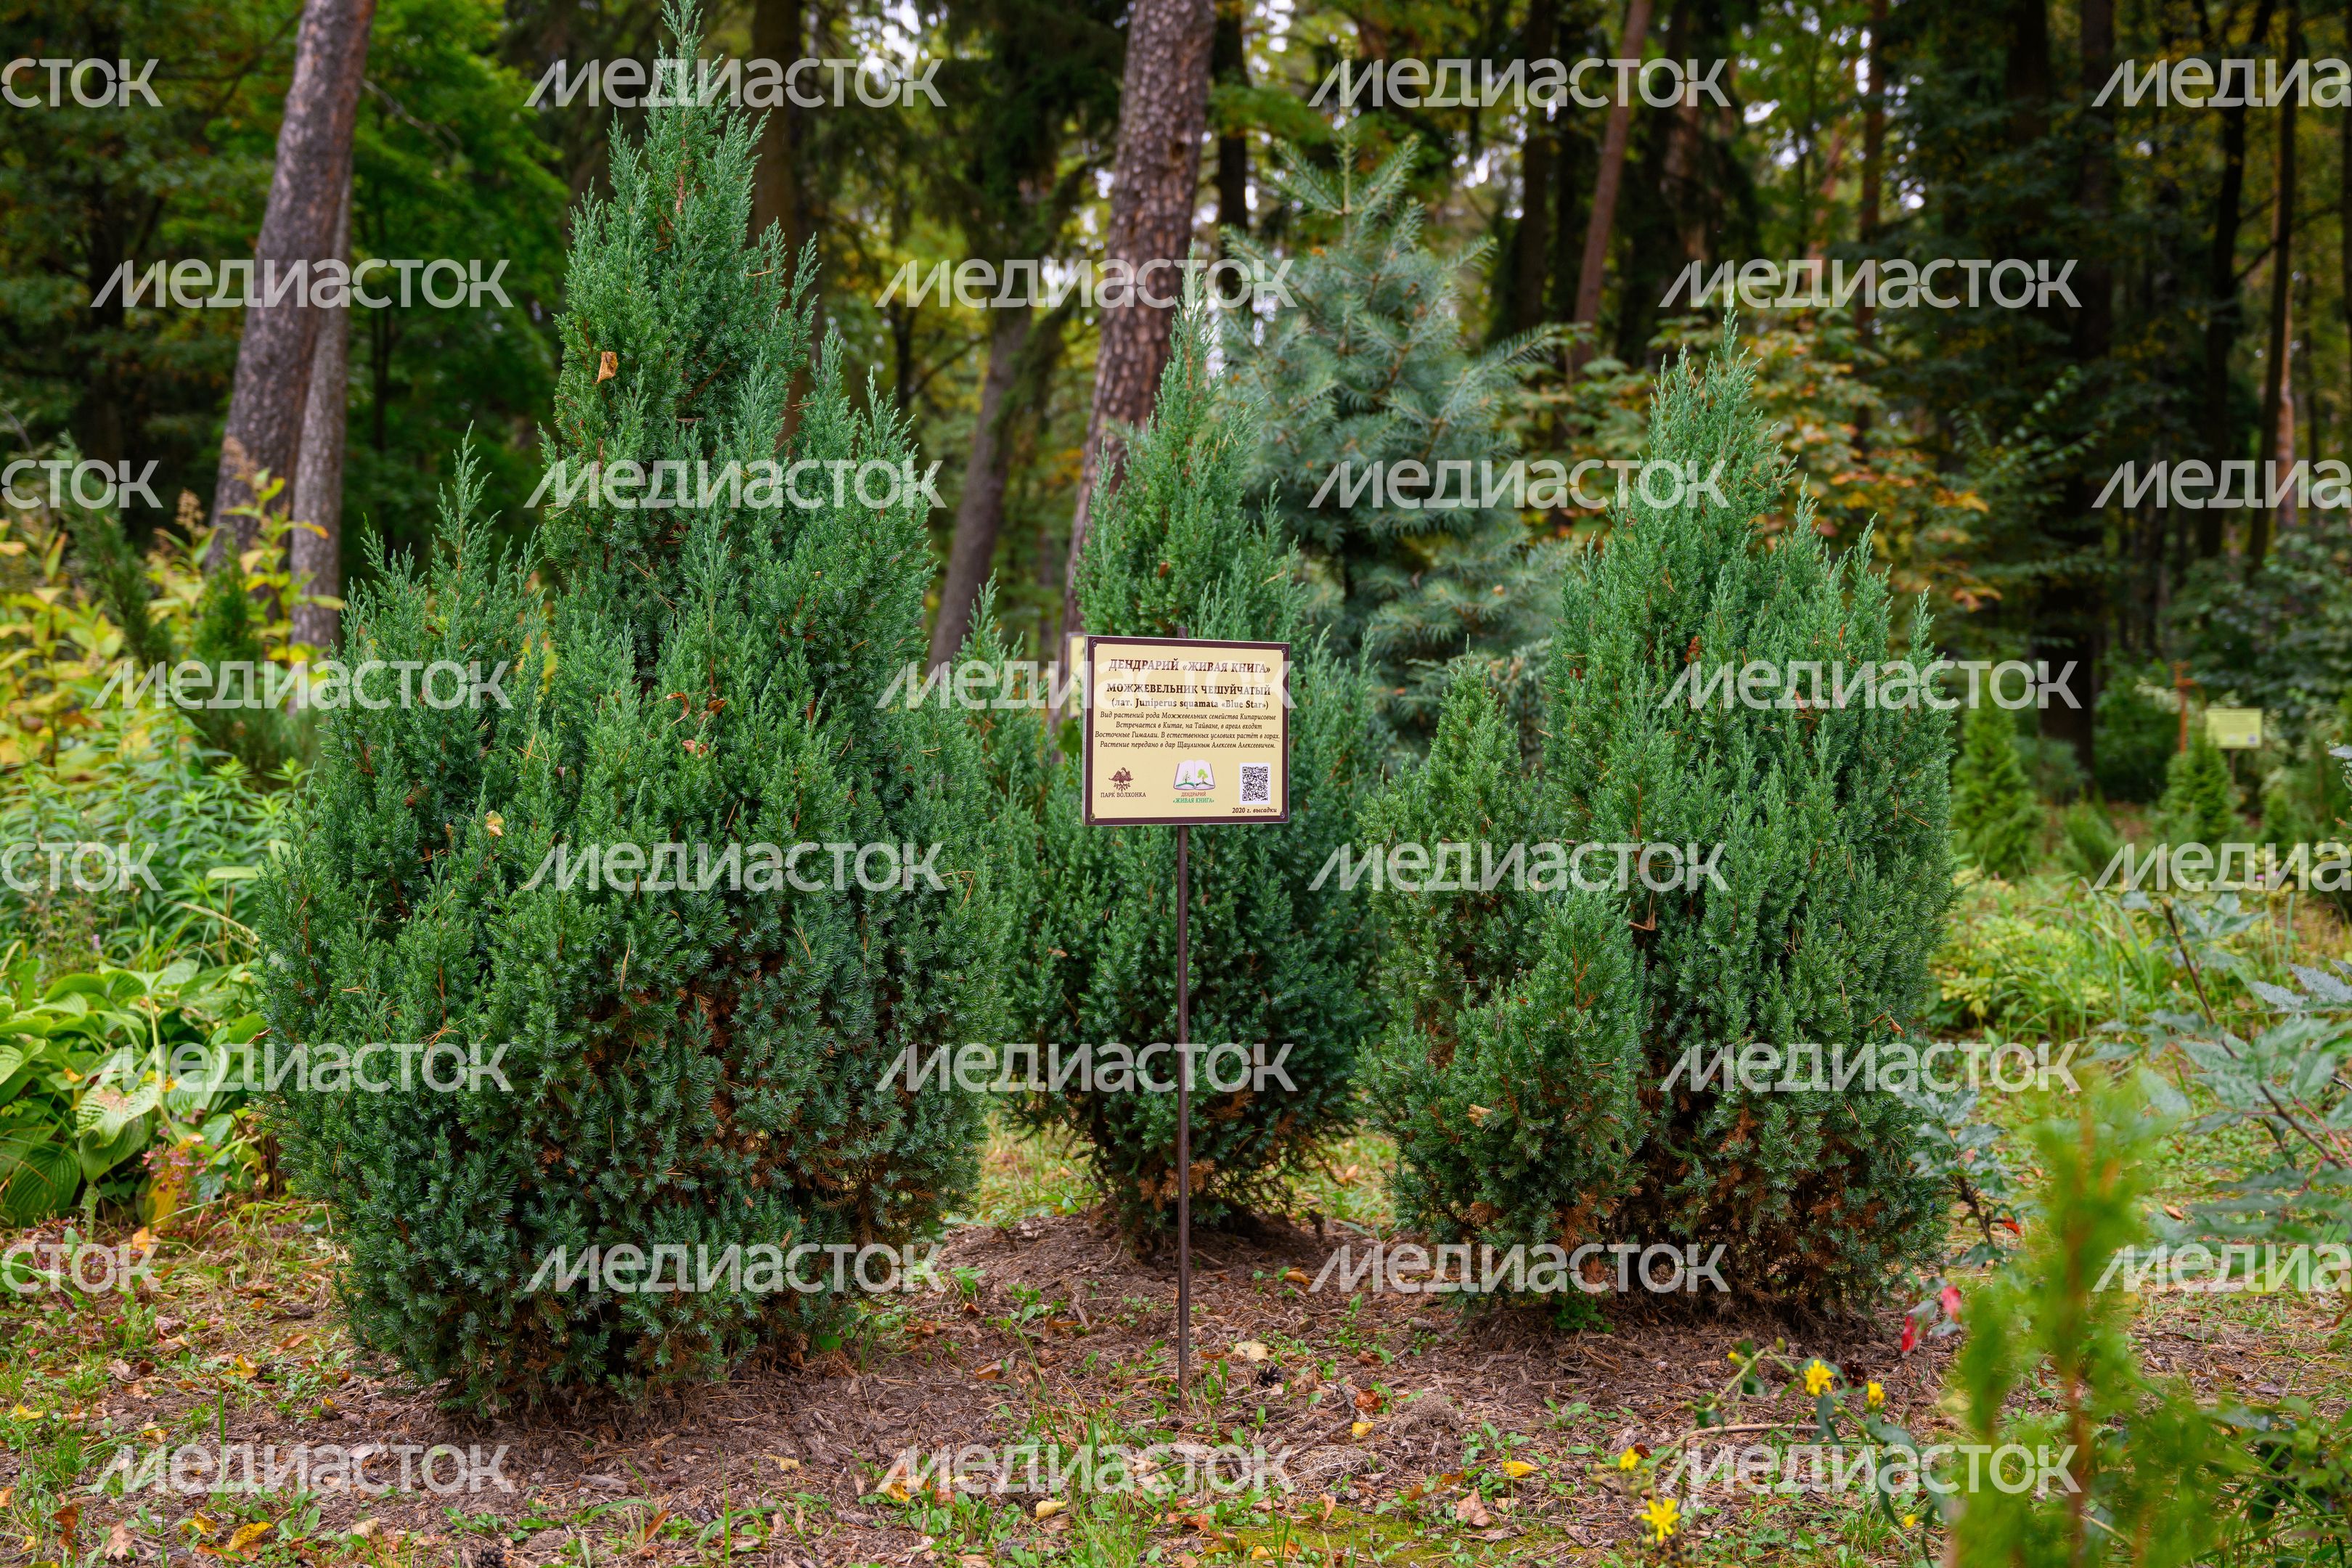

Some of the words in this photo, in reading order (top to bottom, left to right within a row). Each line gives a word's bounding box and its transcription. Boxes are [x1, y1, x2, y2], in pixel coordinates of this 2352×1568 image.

[1109, 658, 1179, 671] ДЕНДРАРИЙ
[1183, 661, 1228, 672] «ЖИВАЯ
[1231, 663, 1270, 673] КНИГА»
[1106, 683, 1198, 694] МОЖЖЕВЕЛЬНИК
[1201, 684, 1270, 695] ЧЕШУЙЧАТЫЙ
[1111, 698, 1132, 708] (лат.
[1135, 698, 1177, 709] Juniperus
[1180, 701, 1218, 709] squamata
[1246, 701, 1269, 710] Star»)
